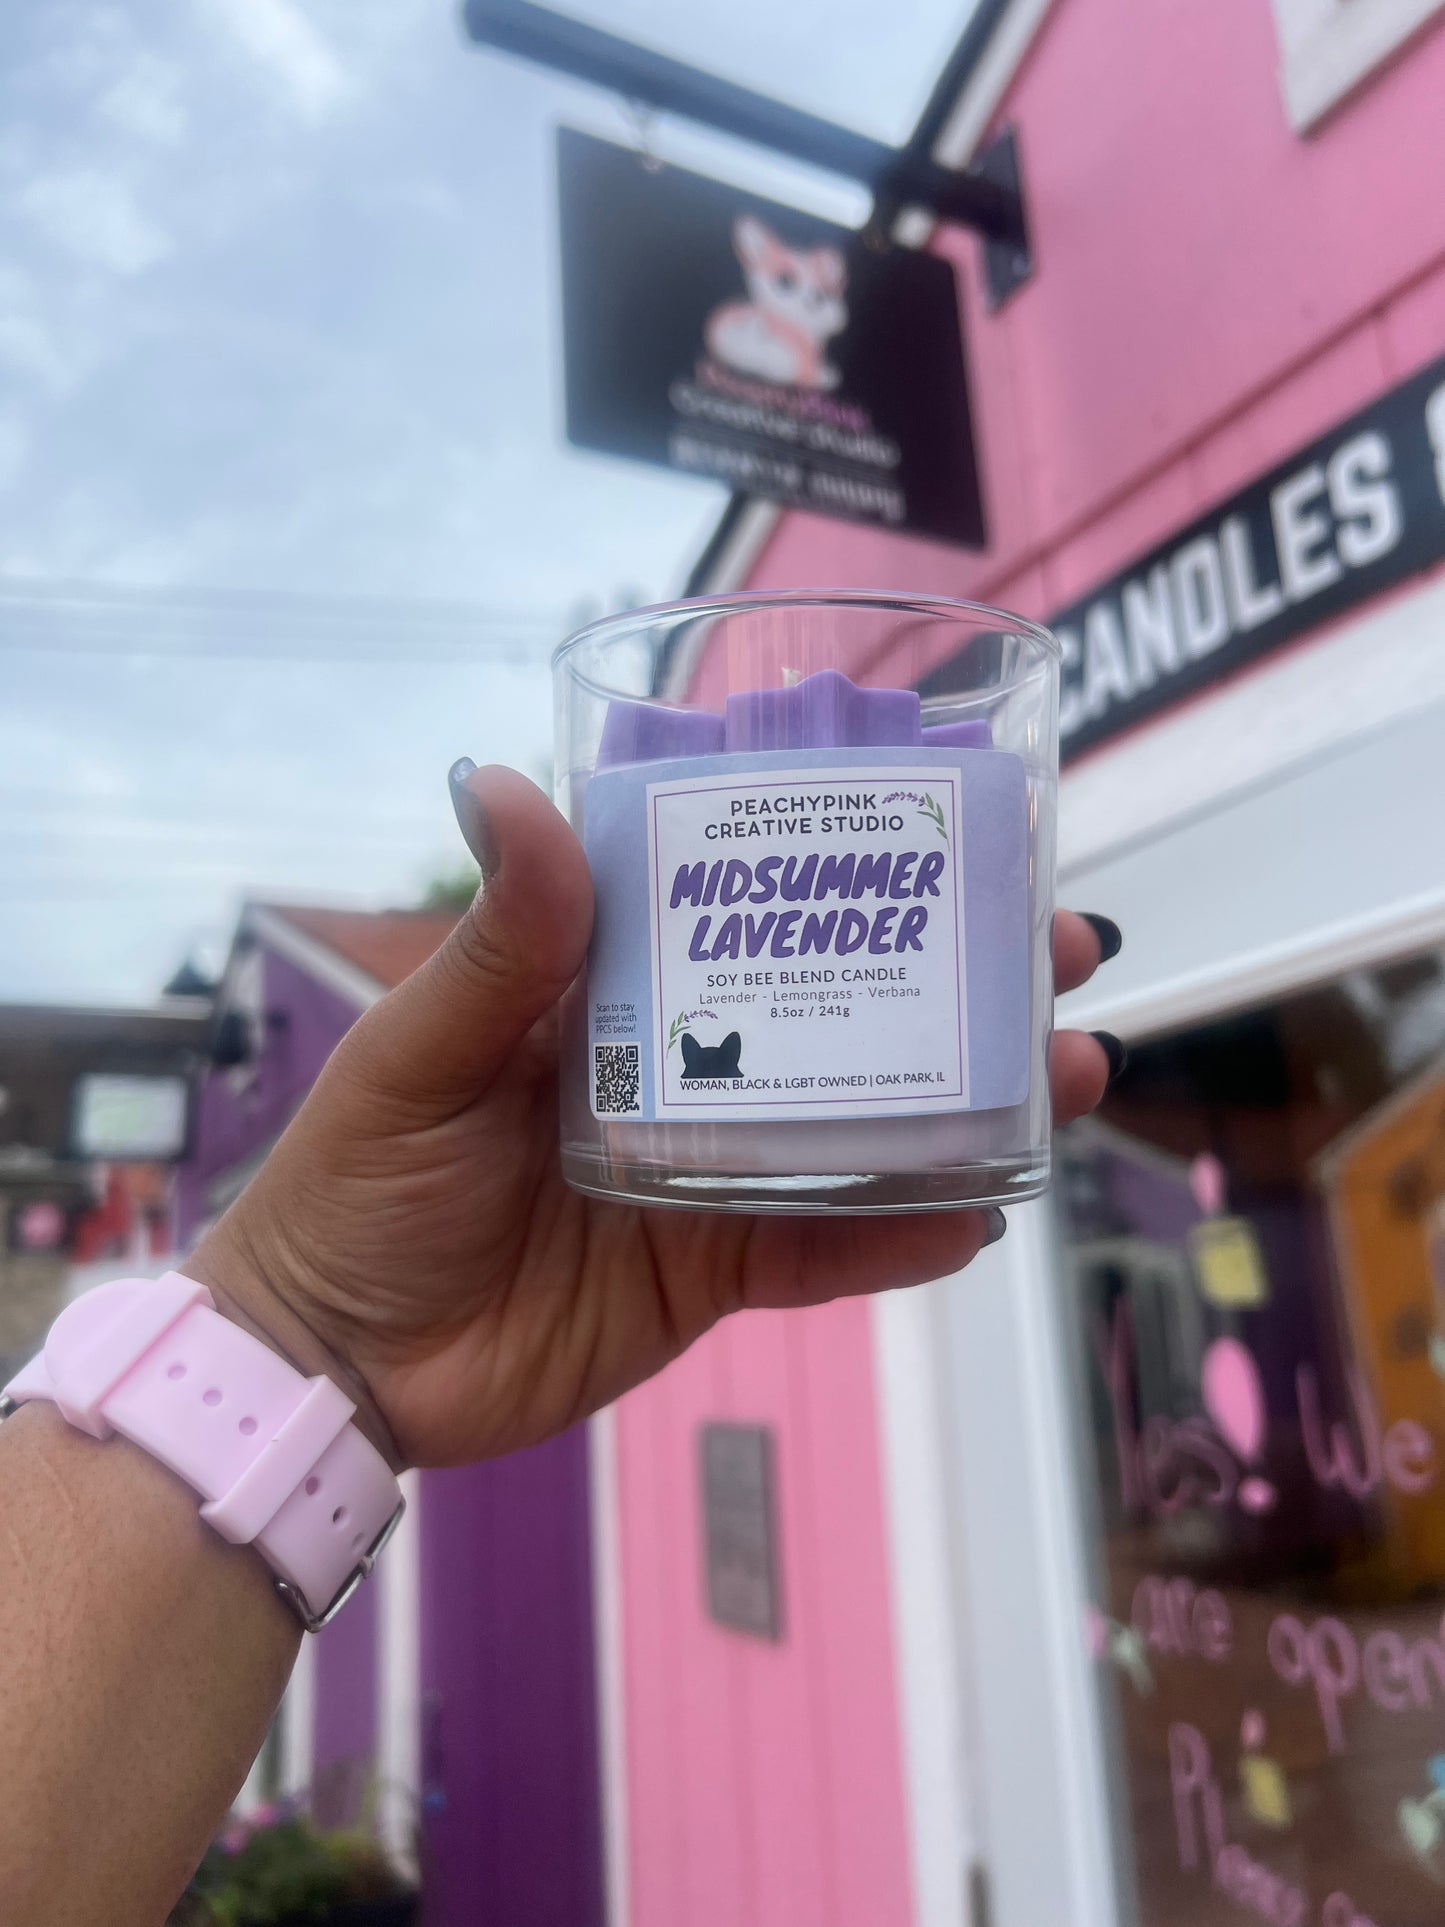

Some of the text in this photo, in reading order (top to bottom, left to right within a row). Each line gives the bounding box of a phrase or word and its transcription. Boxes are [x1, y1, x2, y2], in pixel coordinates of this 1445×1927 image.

[1058, 430, 1402, 738] CANDLES
[730, 793, 877, 816] PEACHYPINK
[704, 815, 904, 840] CREATIVE STUDIO
[669, 850, 945, 909] MIDSUMMER
[688, 905, 928, 961] LAVENDER
[707, 967, 907, 987] SOY BEE BLEND CANDLE
[699, 992, 757, 1005] Lavender
[773, 988, 853, 1003] Lemongrass
[868, 986, 921, 999] Verbana
[595, 1012, 637, 1025] updated with
[596, 1003, 635, 1014] Scan to stay
[770, 1006, 804, 1018] 8.5oz
[819, 1005, 850, 1018] 241g
[596, 1023, 637, 1034] PPCS below!
[680, 1079, 730, 1092] WOMAN,
[732, 1078, 770, 1090] BLACK
[773, 1078, 782, 1089] &
[785, 1077, 815, 1089] LGBT
[818, 1075, 867, 1088] OWNED
[875, 1073, 902, 1086] OAK
[904, 1072, 934, 1084] PARK,
[936, 1071, 945, 1082] IL
[1296, 1350, 1435, 1498] We
